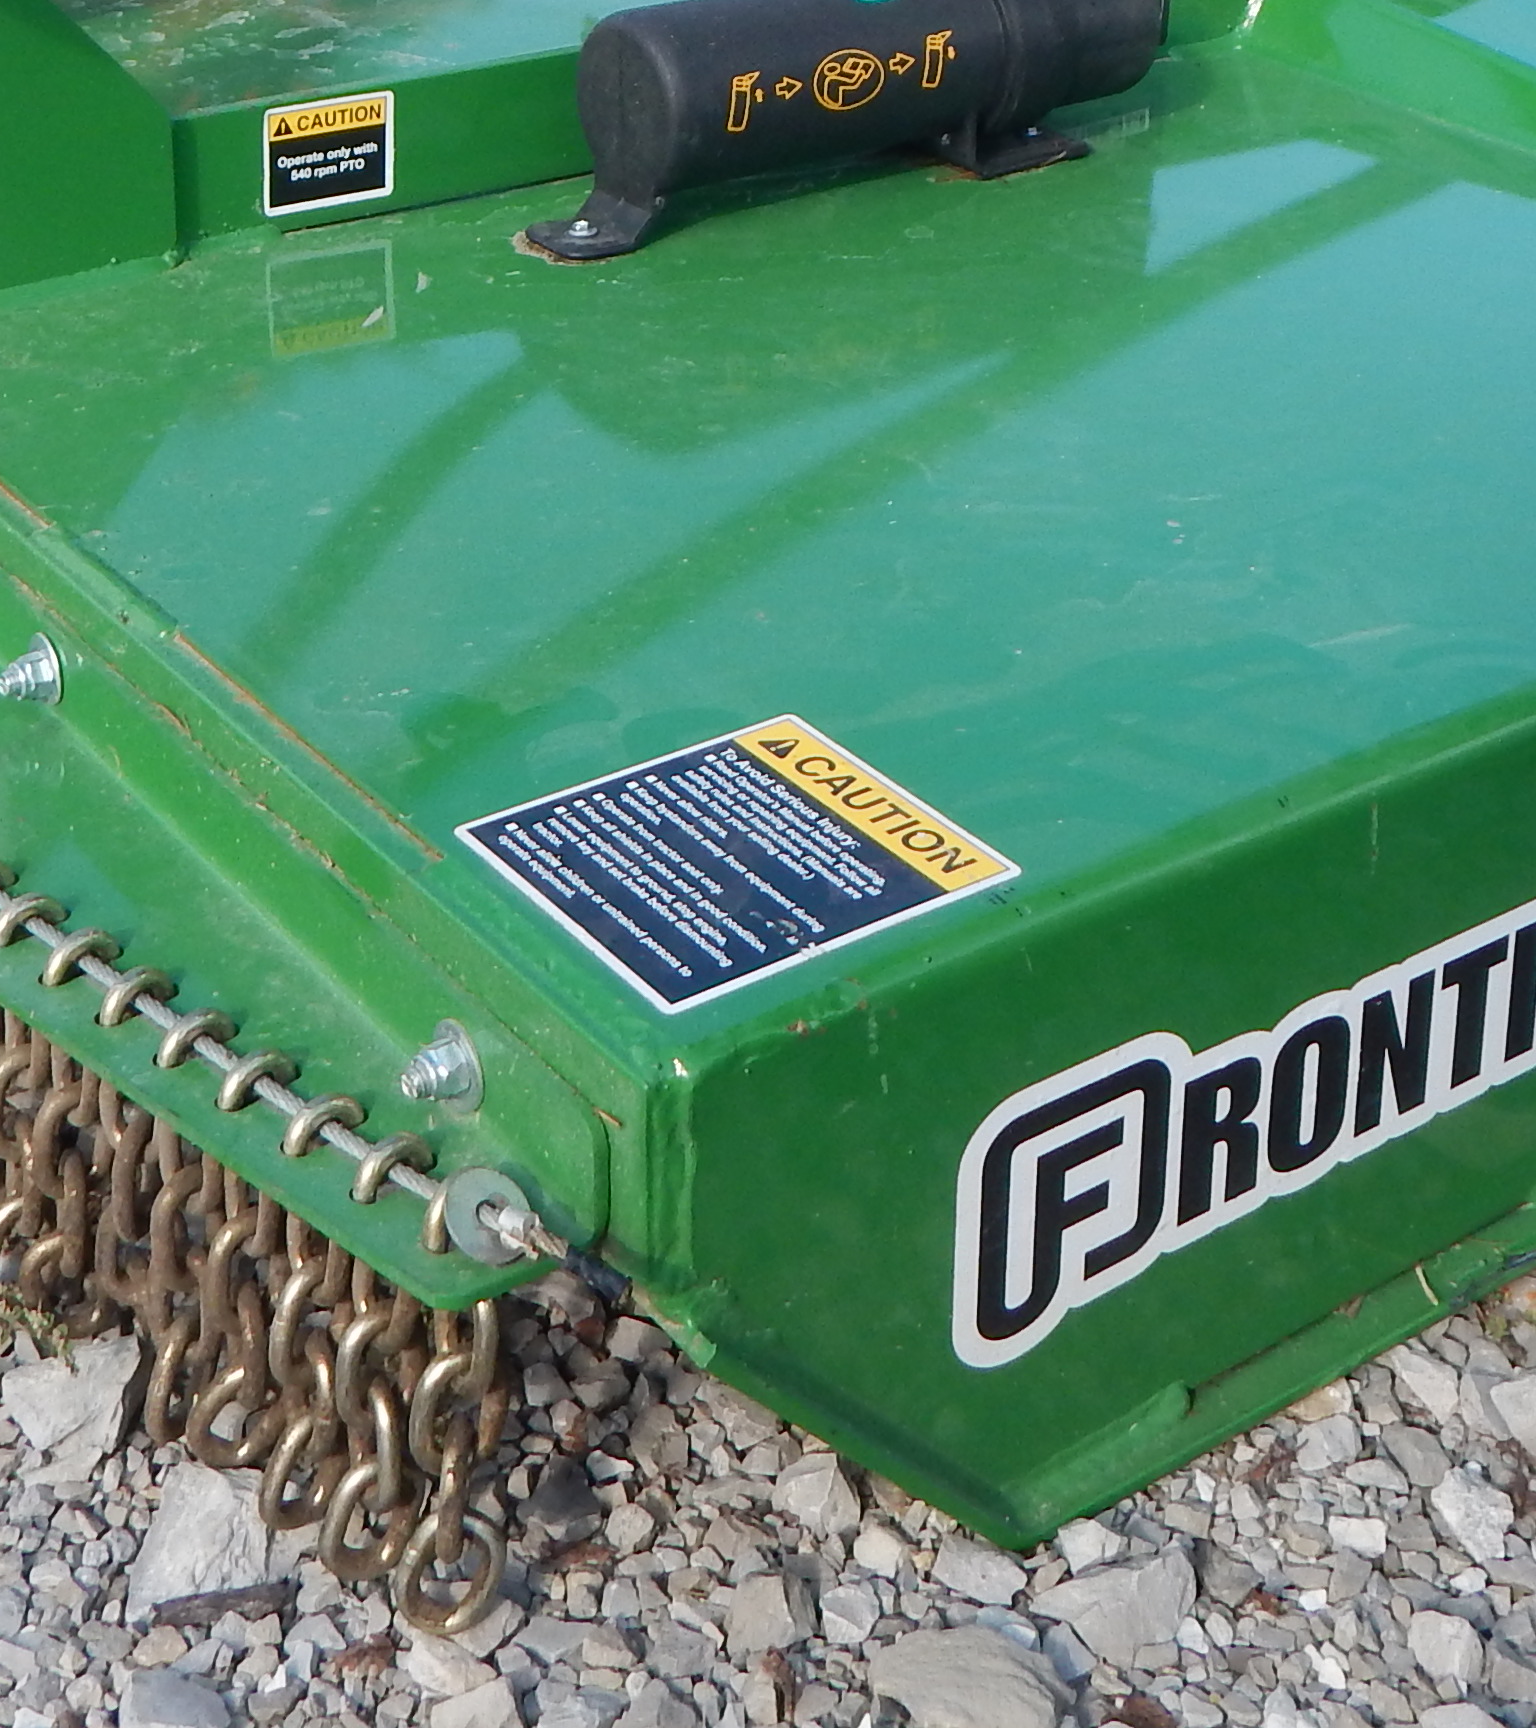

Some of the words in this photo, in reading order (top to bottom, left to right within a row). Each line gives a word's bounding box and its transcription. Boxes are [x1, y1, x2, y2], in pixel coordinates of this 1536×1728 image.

[297, 104, 381, 132] CAUTION
[277, 151, 325, 169] Operate
[326, 146, 352, 160] only
[353, 141, 379, 156] with
[314, 164, 338, 178] rpm
[340, 158, 365, 172] PTO
[716, 748, 744, 762] To
[732, 760, 776, 785] Avoid
[767, 785, 822, 818] Serious
[813, 819, 863, 848] Injury:
[794, 754, 978, 875] CAUTION
